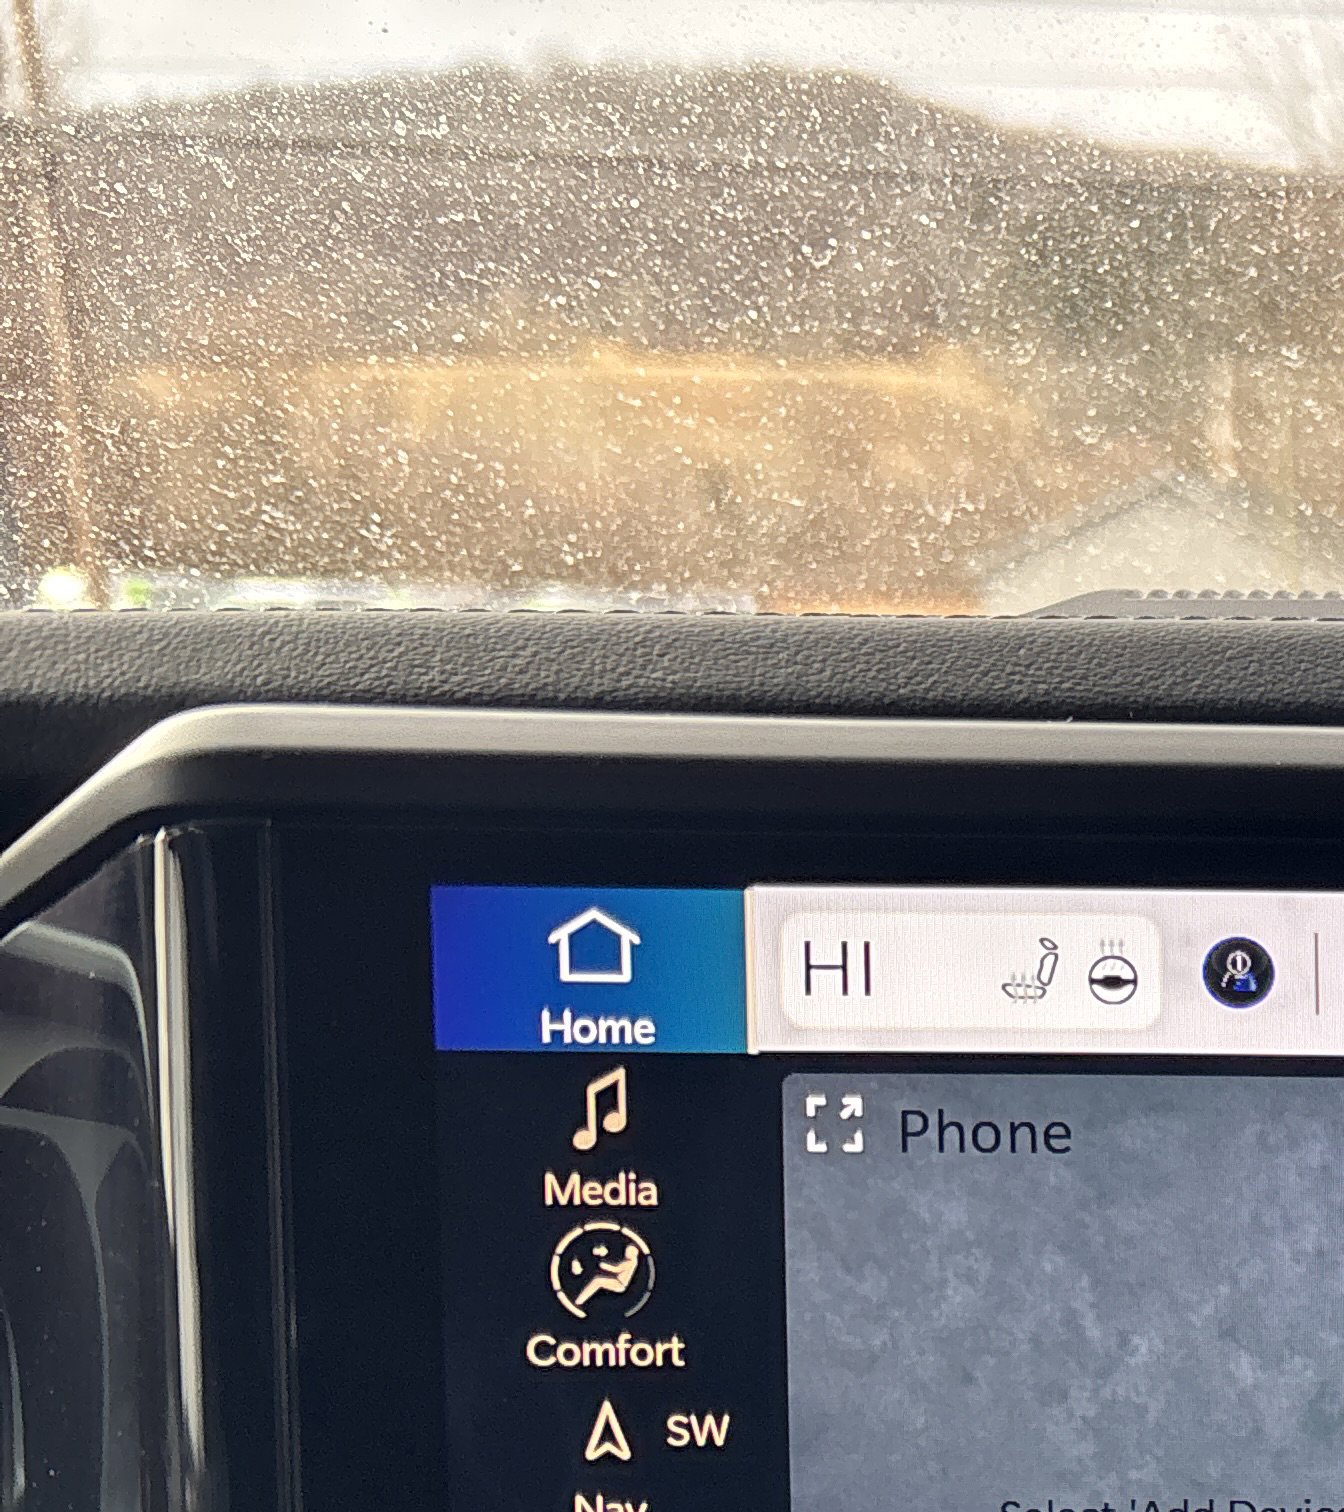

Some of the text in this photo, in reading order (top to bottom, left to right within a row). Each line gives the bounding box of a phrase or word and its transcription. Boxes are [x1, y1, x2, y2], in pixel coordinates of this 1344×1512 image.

[803, 940, 872, 997] HI
[540, 1007, 655, 1047] Home
[899, 1107, 1074, 1155] Phone
[543, 1172, 658, 1208] Media
[526, 1335, 686, 1369] Comfort
[666, 1413, 730, 1447] SW
